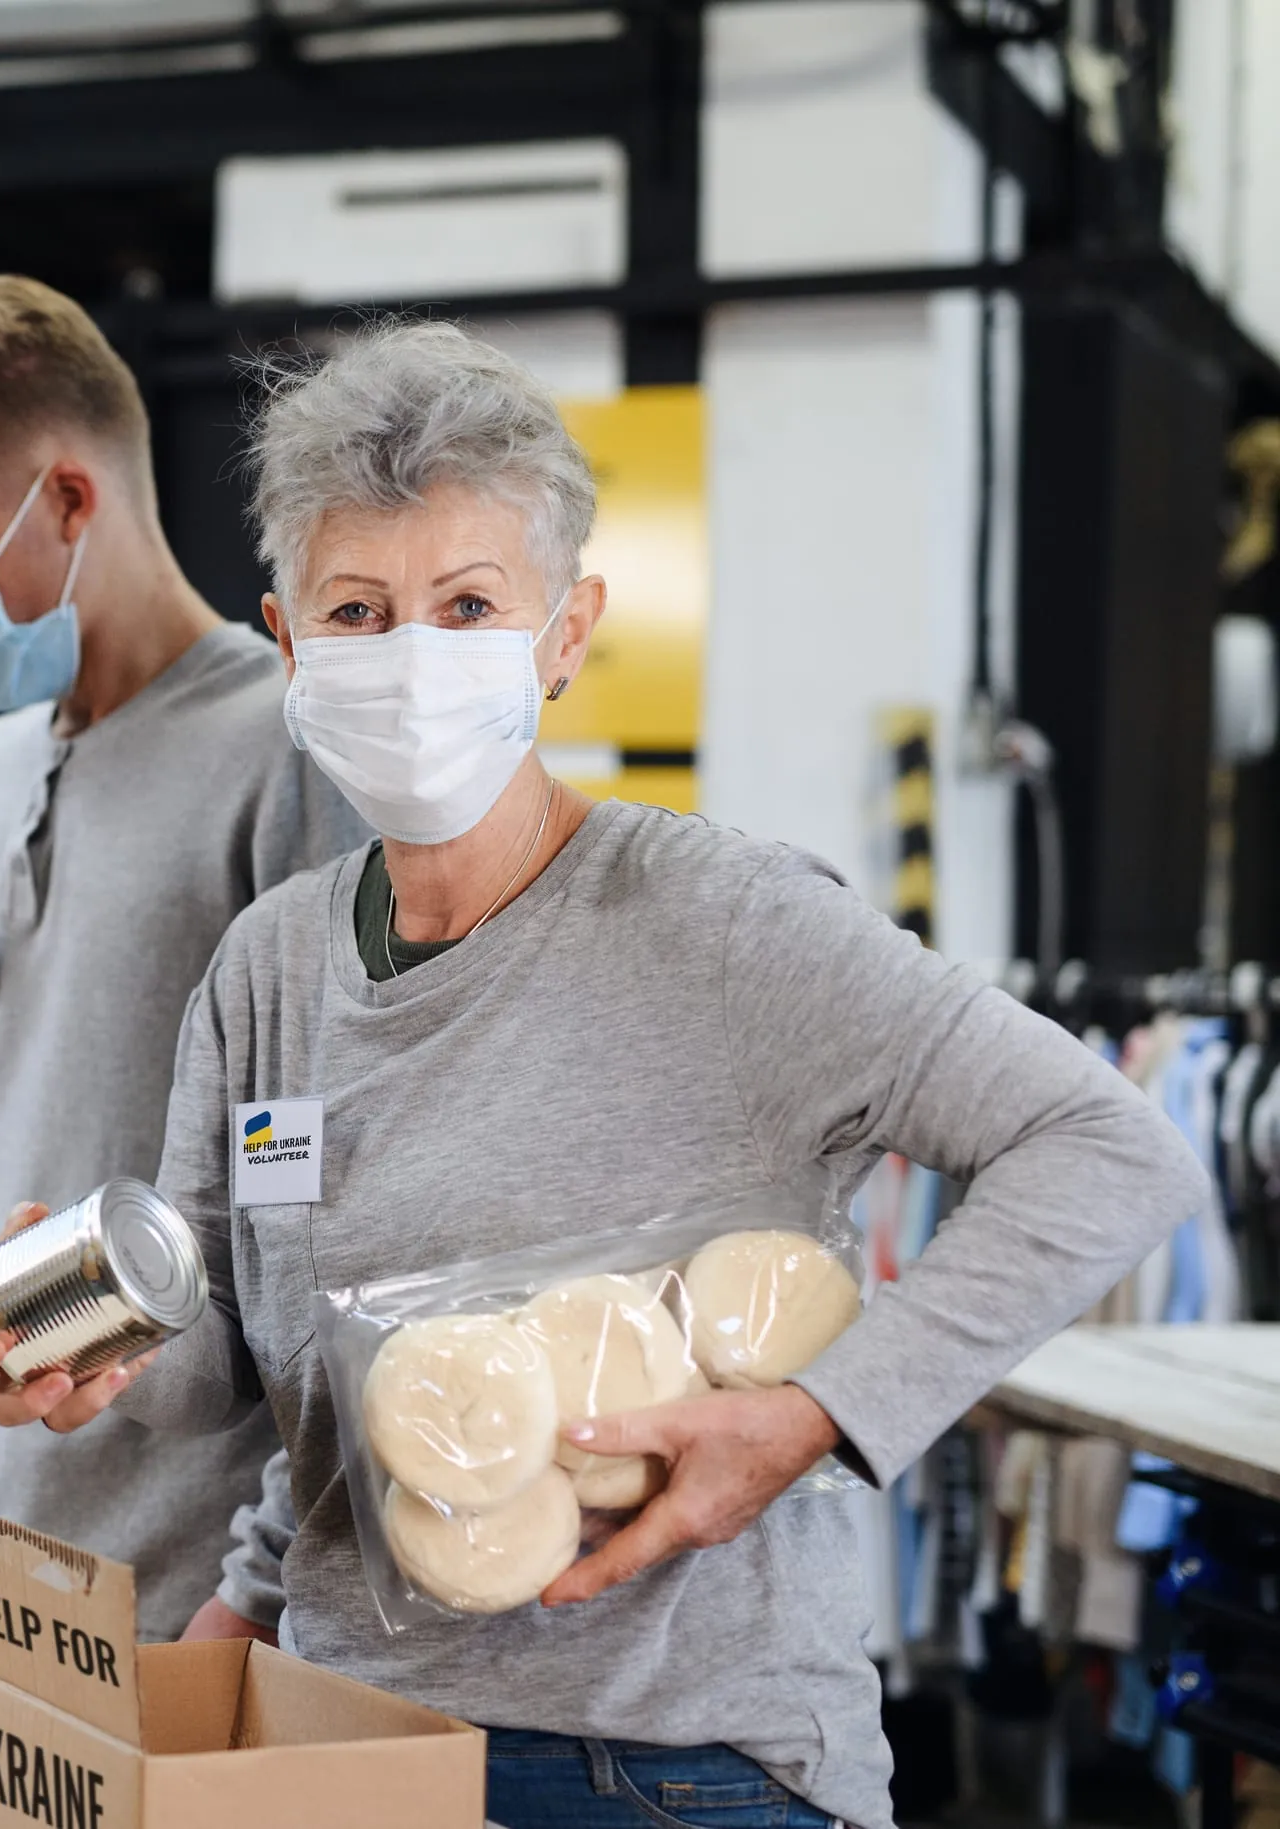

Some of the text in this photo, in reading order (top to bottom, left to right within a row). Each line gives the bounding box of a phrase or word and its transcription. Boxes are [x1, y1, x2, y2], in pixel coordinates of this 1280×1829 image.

[243, 1135, 312, 1154] HELP FOR UKRAINE
[248, 1150, 310, 1165] VOLUNTEER
[52, 1619, 121, 1688] FOR
